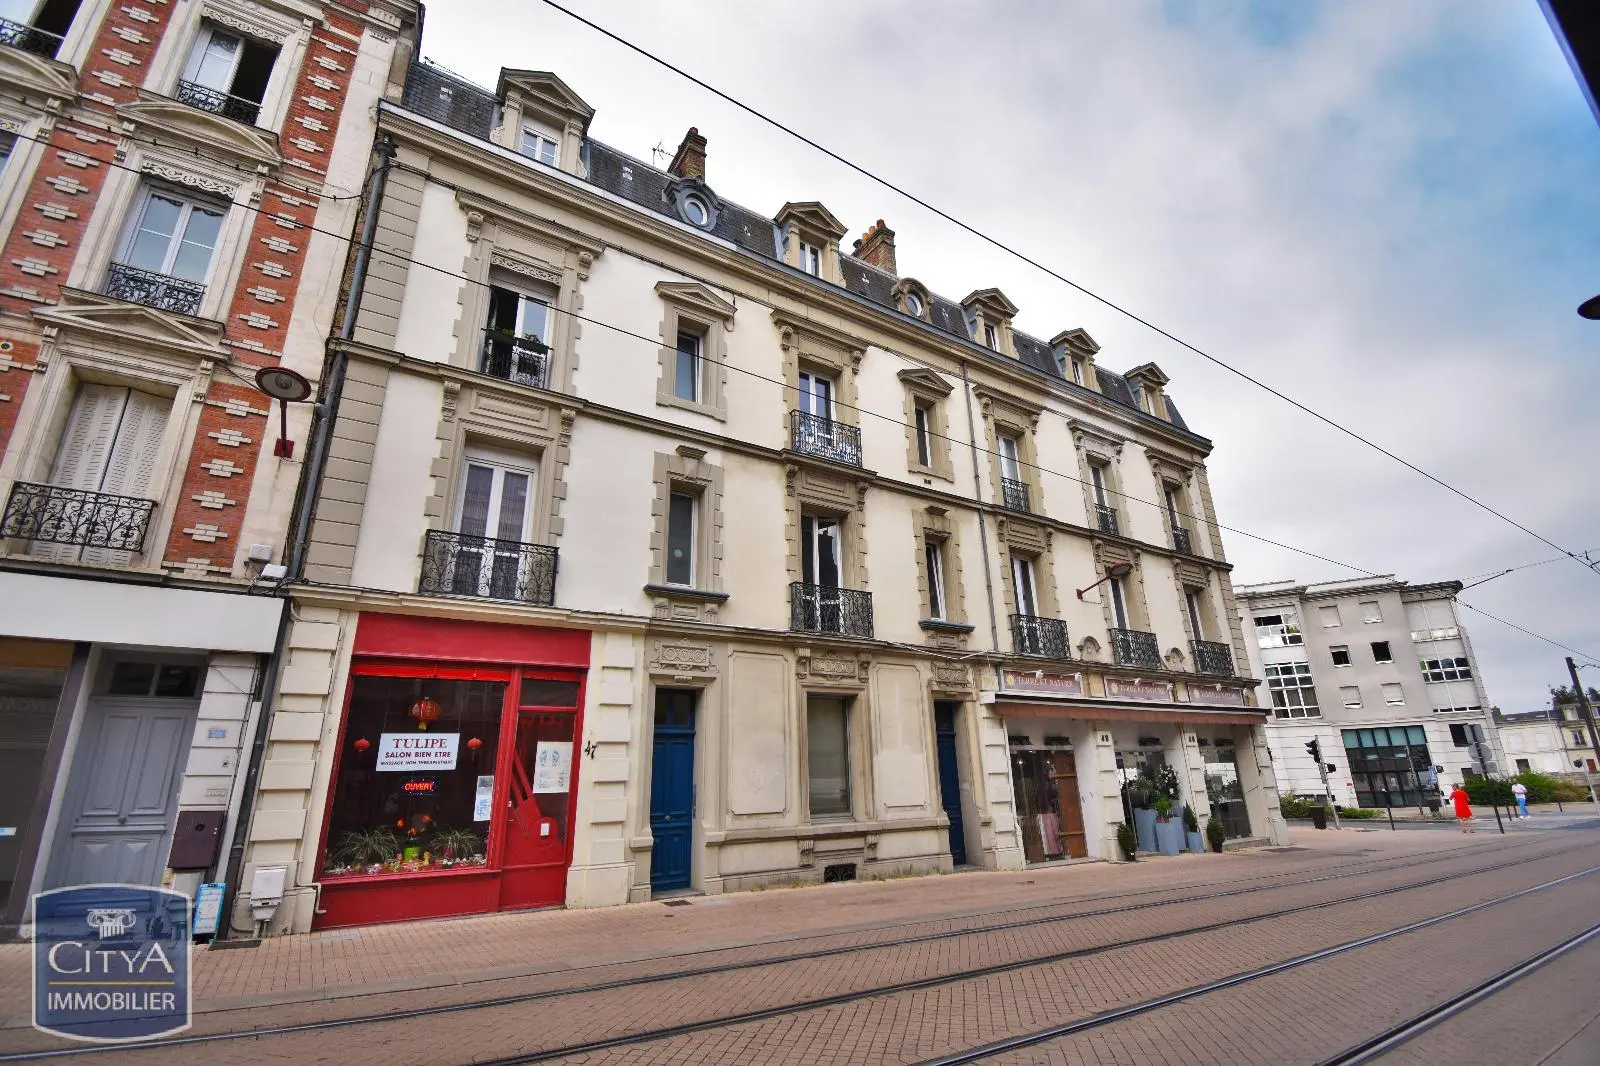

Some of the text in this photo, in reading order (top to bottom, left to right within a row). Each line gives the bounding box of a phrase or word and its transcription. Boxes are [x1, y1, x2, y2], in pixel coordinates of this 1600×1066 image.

[1049, 679, 1073, 688] NATURE
[393, 738, 448, 749] TULIPE
[584, 740, 598, 760] 47
[404, 782, 433, 791] OUVERT
